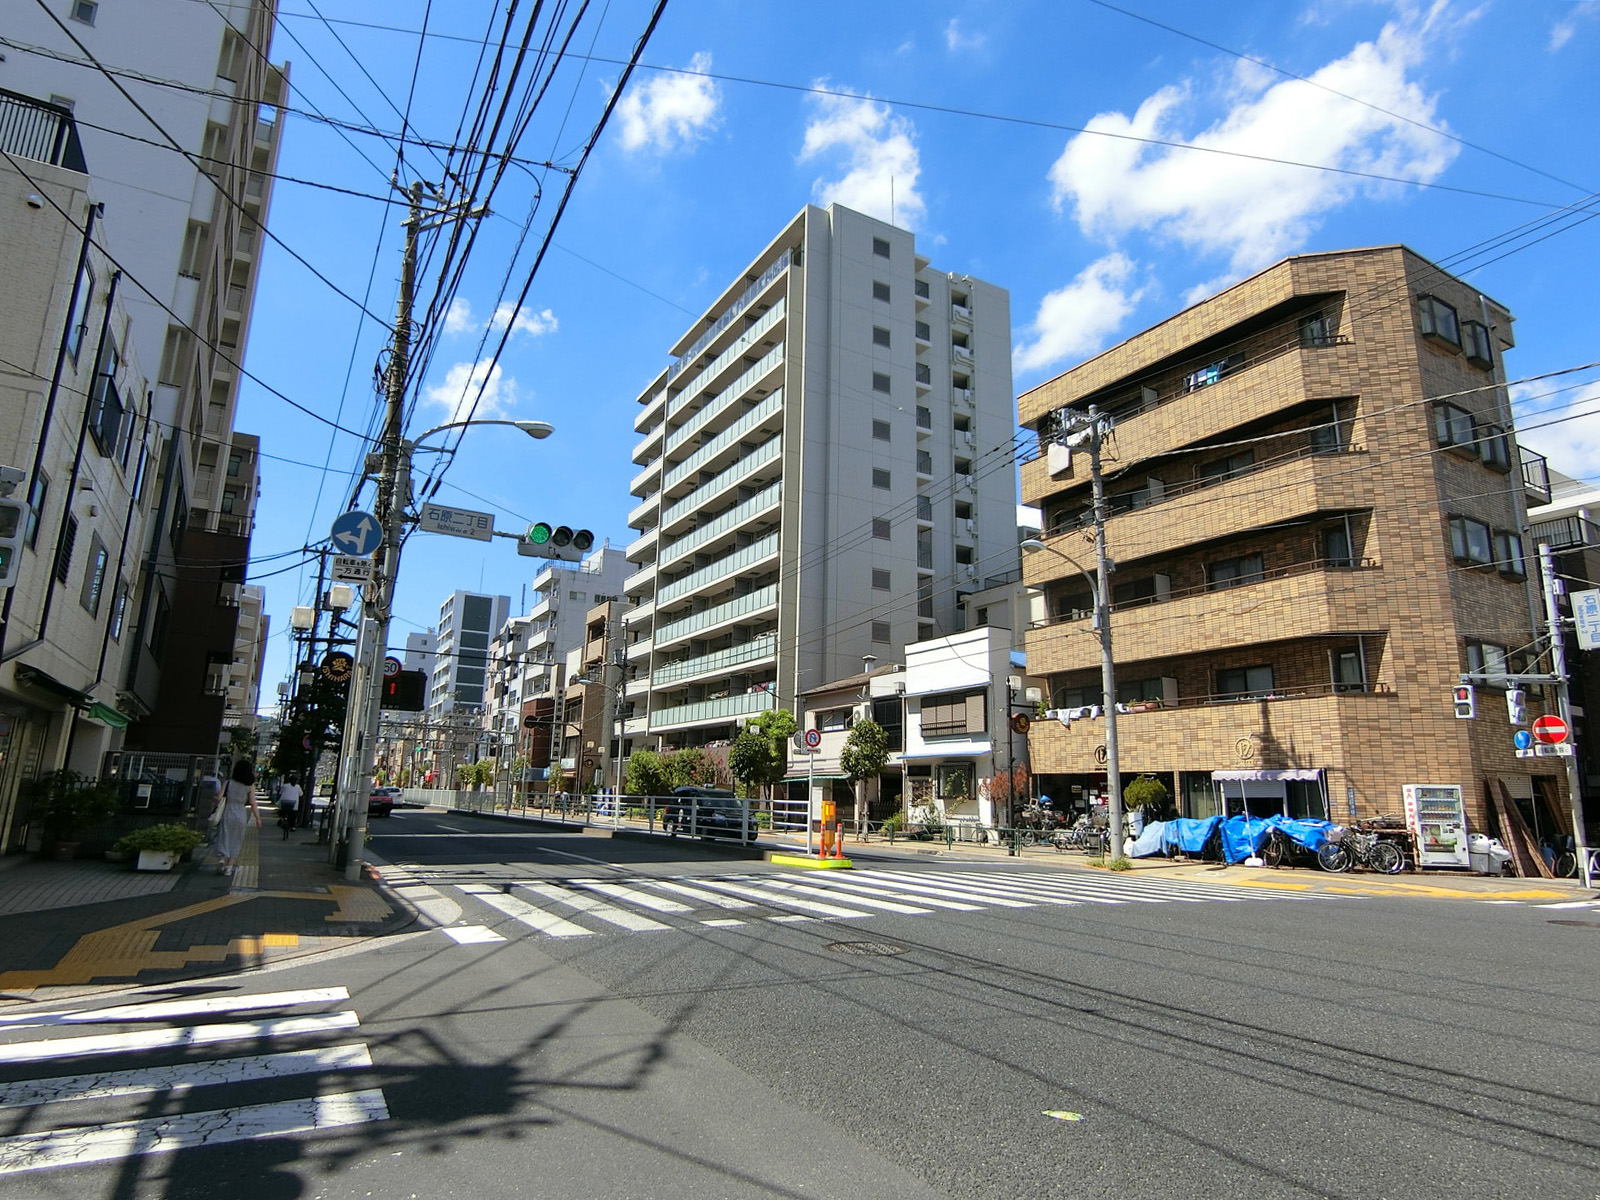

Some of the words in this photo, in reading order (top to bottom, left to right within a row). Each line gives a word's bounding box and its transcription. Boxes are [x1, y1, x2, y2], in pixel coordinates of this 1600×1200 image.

[427, 508, 488, 529] 石原二丁目
[335, 567, 370, 576] 一方通行
[384, 662, 397, 673] 50
